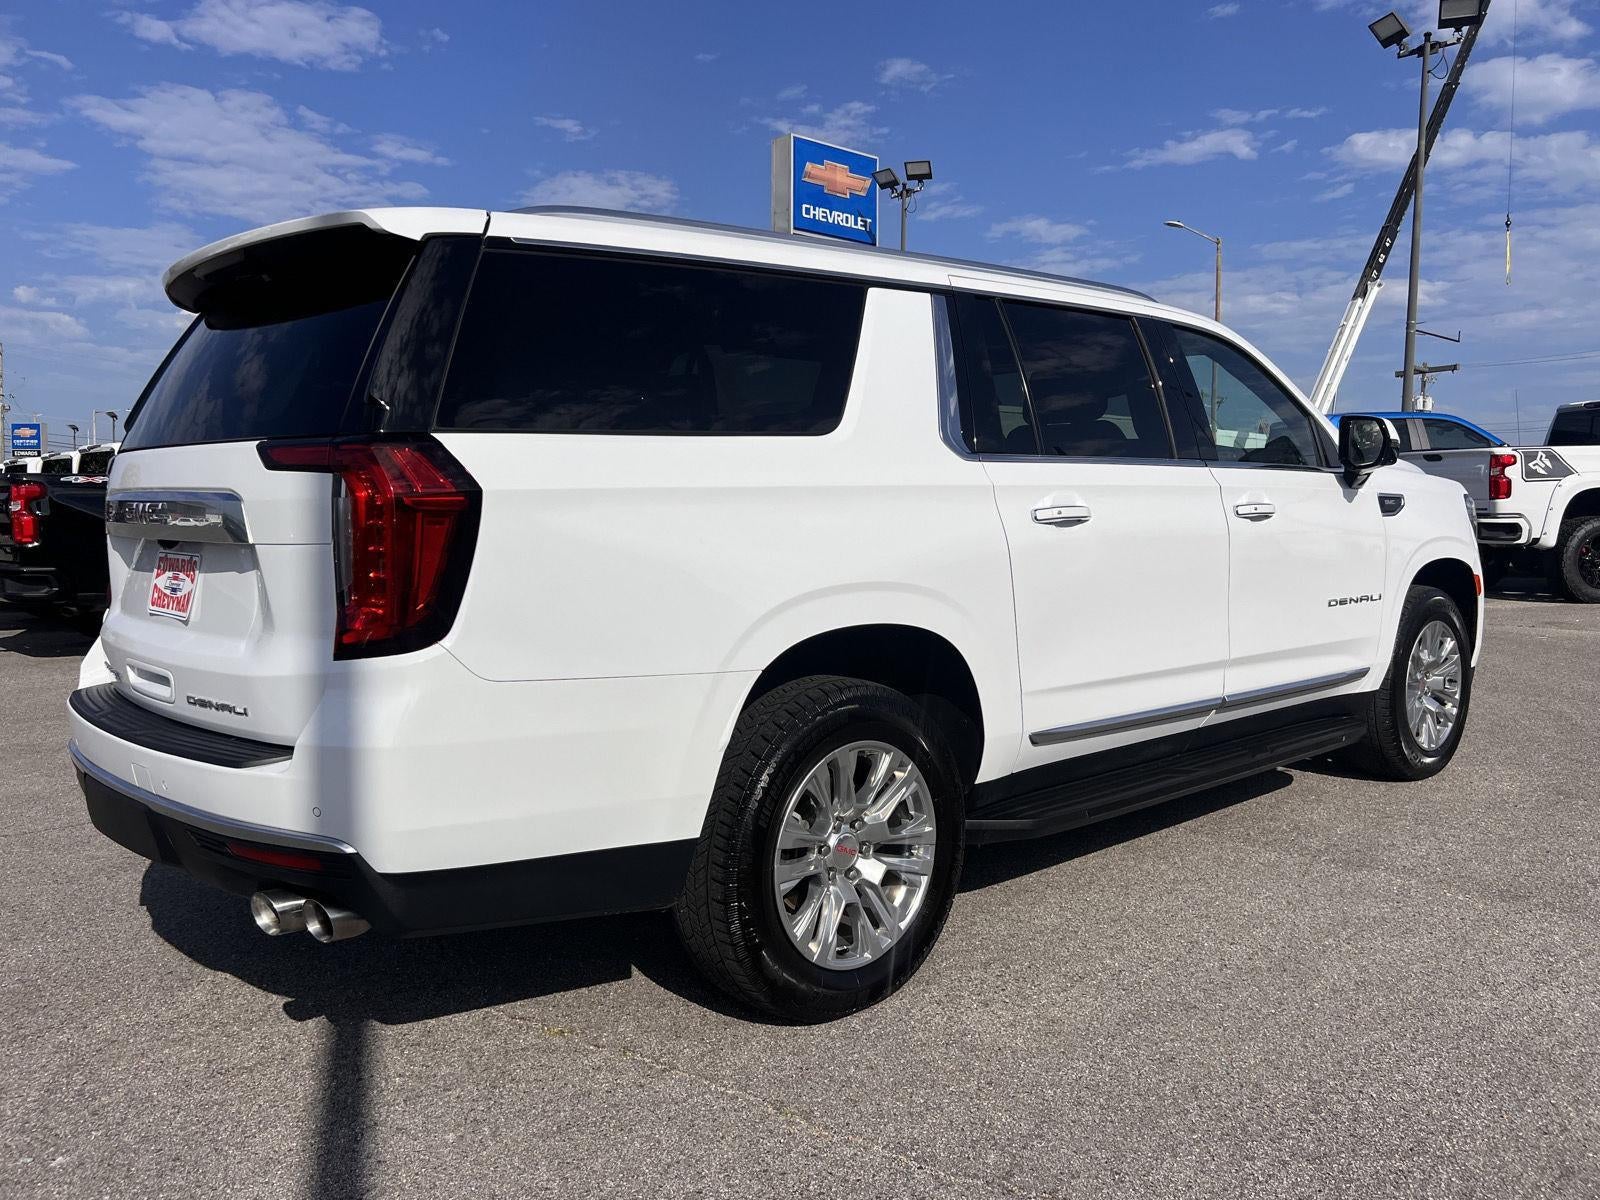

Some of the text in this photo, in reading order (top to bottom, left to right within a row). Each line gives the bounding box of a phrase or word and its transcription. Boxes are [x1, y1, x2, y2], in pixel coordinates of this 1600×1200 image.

[802, 204, 872, 231] CHEVROLET
[155, 556, 198, 585] EDWARDS
[151, 583, 193, 613] CHEVYMAN
[1328, 593, 1382, 607] DENALI
[186, 695, 249, 717] DENALI
[836, 845, 856, 856] GMC
